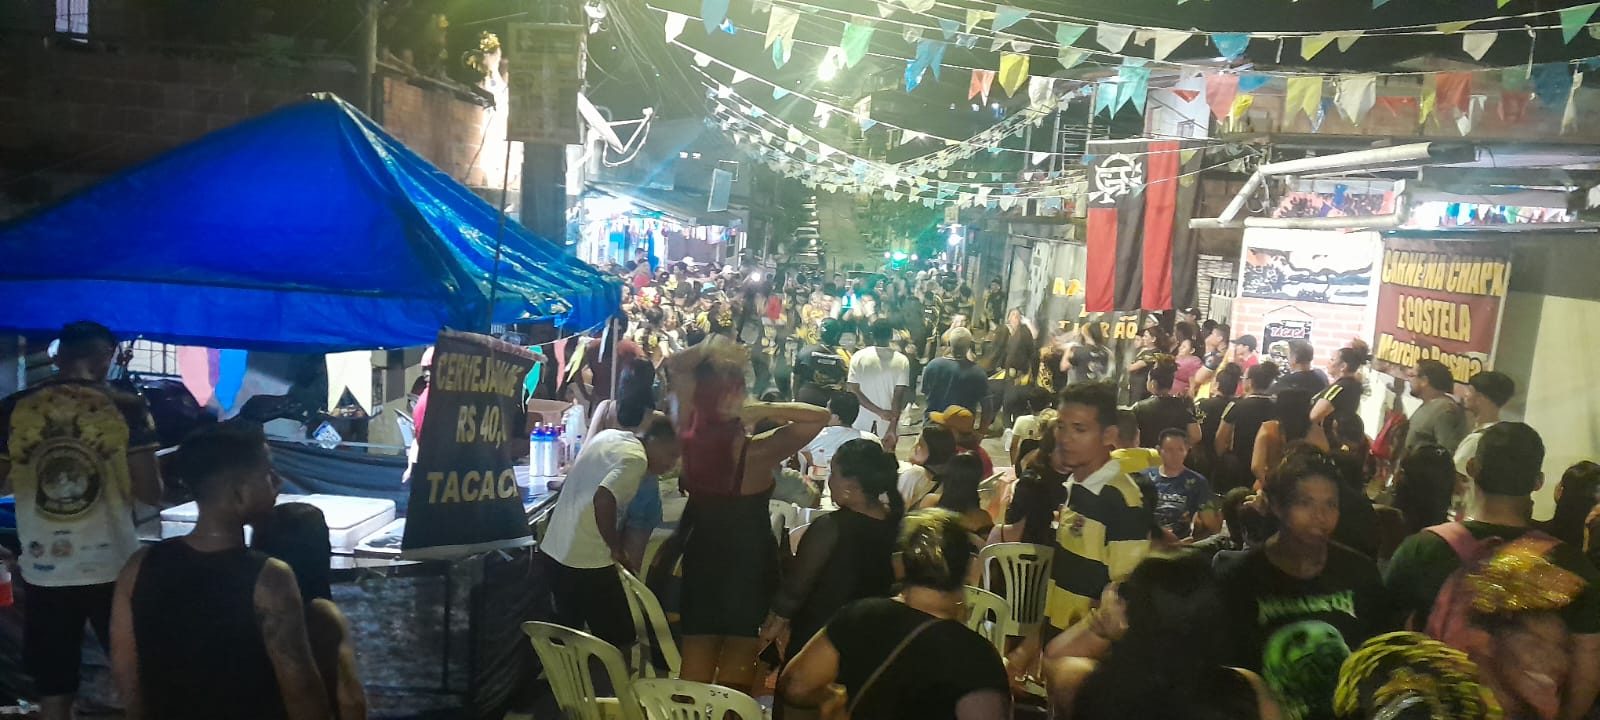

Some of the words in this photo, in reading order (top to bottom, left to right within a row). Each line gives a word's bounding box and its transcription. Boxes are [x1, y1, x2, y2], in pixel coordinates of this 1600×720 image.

[1382, 250, 1424, 287] CARNE
[1424, 254, 1446, 290] NA
[1397, 294, 1405, 329] E
[1405, 295, 1471, 342] COSTELA
